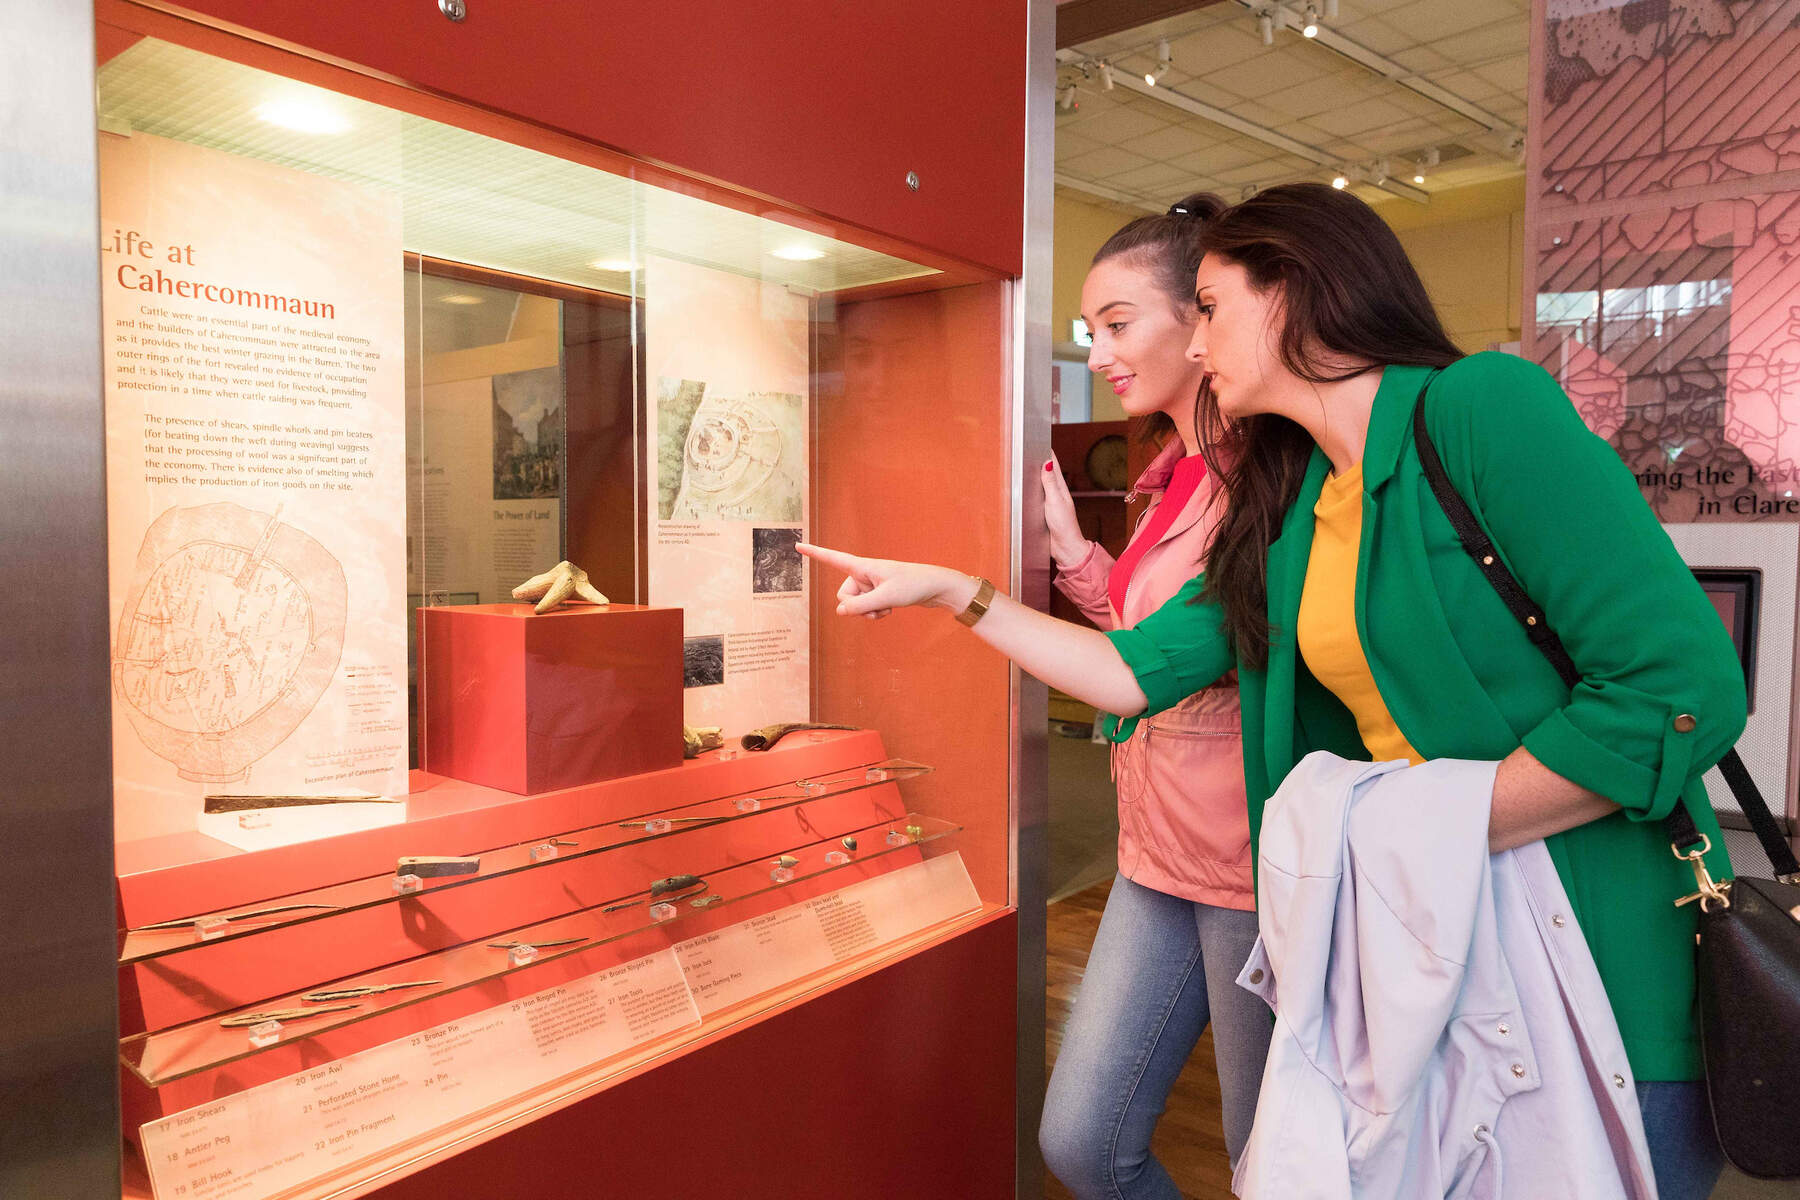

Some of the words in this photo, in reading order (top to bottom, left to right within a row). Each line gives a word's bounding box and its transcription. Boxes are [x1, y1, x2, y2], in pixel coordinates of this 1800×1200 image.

[101, 229, 153, 259] ife
[167, 244, 196, 266] at
[117, 264, 335, 319] Cahercommaun
[116, 319, 135, 329] and
[139, 320, 154, 331] the
[157, 323, 194, 336] builders
[197, 329, 207, 338] of
[210, 330, 277, 346] Cahercommaun
[280, 341, 299, 349] were
[302, 342, 337, 354] attracted
[339, 346, 347, 355] to
[350, 348, 363, 357] the
[140, 305, 169, 318] Cattle
[171, 312, 192, 321] were
[197, 315, 208, 323] an
[211, 317, 249, 328] essential
[252, 322, 268, 332] part
[271, 324, 280, 332] of
[283, 325, 297, 334] the
[300, 328, 334, 339] medieval
[336, 334, 371, 347] economy
[116, 335, 128, 343] as
[130, 334, 138, 344] it
[141, 338, 181, 349] provides
[184, 341, 199, 351] the
[202, 343, 220, 353] best
[223, 346, 251, 357] winter
[254, 351, 285, 364] grazing
[288, 353, 296, 362] in
[299, 355, 312, 364] the
[346, 360, 360, 370] The
[362, 362, 377, 372] two
[116, 349, 142, 360] outer
[147, 352, 170, 365] rings
[173, 355, 184, 364] of
[187, 356, 201, 366] the
[205, 358, 221, 368] fort
[224, 362, 259, 372] revealed
[276, 367, 311, 378] evidence
[314, 370, 323, 379] of
[325, 373, 368, 384] occupation
[116, 364, 136, 374] and
[140, 366, 146, 375] it
[150, 367, 158, 376] is
[161, 368, 184, 382] likely
[188, 371, 206, 381] that
[210, 373, 229, 386] they
[232, 377, 252, 385] were
[255, 379, 274, 388] used
[278, 380, 290, 389] for
[331, 387, 367, 399] providing
[117, 381, 167, 392] protection
[171, 384, 180, 394] in
[192, 386, 212, 396] time
[215, 389, 239, 399] when
[242, 391, 266, 401] cattle
[144, 414, 162, 424] The
[165, 418, 205, 427] presence
[208, 419, 217, 428] of
[252, 422, 282, 434] spindle
[314, 427, 329, 435] and
[331, 428, 344, 439] pin
[346, 429, 373, 438] beaters
[144, 429, 162, 441] (for
[165, 430, 200, 444] beating
[203, 433, 228, 443] down
[231, 435, 245, 444] the
[270, 437, 297, 450] during
[337, 443, 370, 453] suggests
[145, 443, 164, 453] that
[167, 445, 183, 454] the
[186, 448, 233, 460] processing
[235, 449, 245, 458] of
[248, 450, 269, 459] wool
[297, 453, 339, 464] significant
[341, 456, 356, 466] part
[359, 457, 367, 465] of
[145, 458, 160, 468] the
[211, 462, 235, 471] There
[238, 463, 245, 472] is
[247, 464, 284, 474] evidence
[286, 466, 303, 475] also
[305, 467, 314, 475] of
[317, 468, 349, 479] smelting
[352, 469, 374, 478] which
[1634, 467, 1683, 491] ring
[1696, 466, 1735, 484] the
[145, 474, 178, 486] implies
[182, 475, 197, 485] the
[199, 477, 248, 488] production
[250, 478, 260, 487] of
[263, 479, 280, 488] iron
[282, 480, 307, 491] goods
[323, 481, 336, 490] the
[534, 510, 550, 520] Land
[1699, 496, 1721, 514] in
[1734, 495, 1799, 515] Clare
[295, 1076, 306, 1087] 20
[310, 1070, 326, 1081] Iron
[328, 1064, 343, 1075] Awl
[318, 1087, 357, 1108] Perforated
[358, 1080, 380, 1094] Stone
[177, 1115, 195, 1127] Iron
[328, 1133, 346, 1146] Iron
[361, 1113, 396, 1133] Fragment
[214, 1134, 231, 1146] Peg
